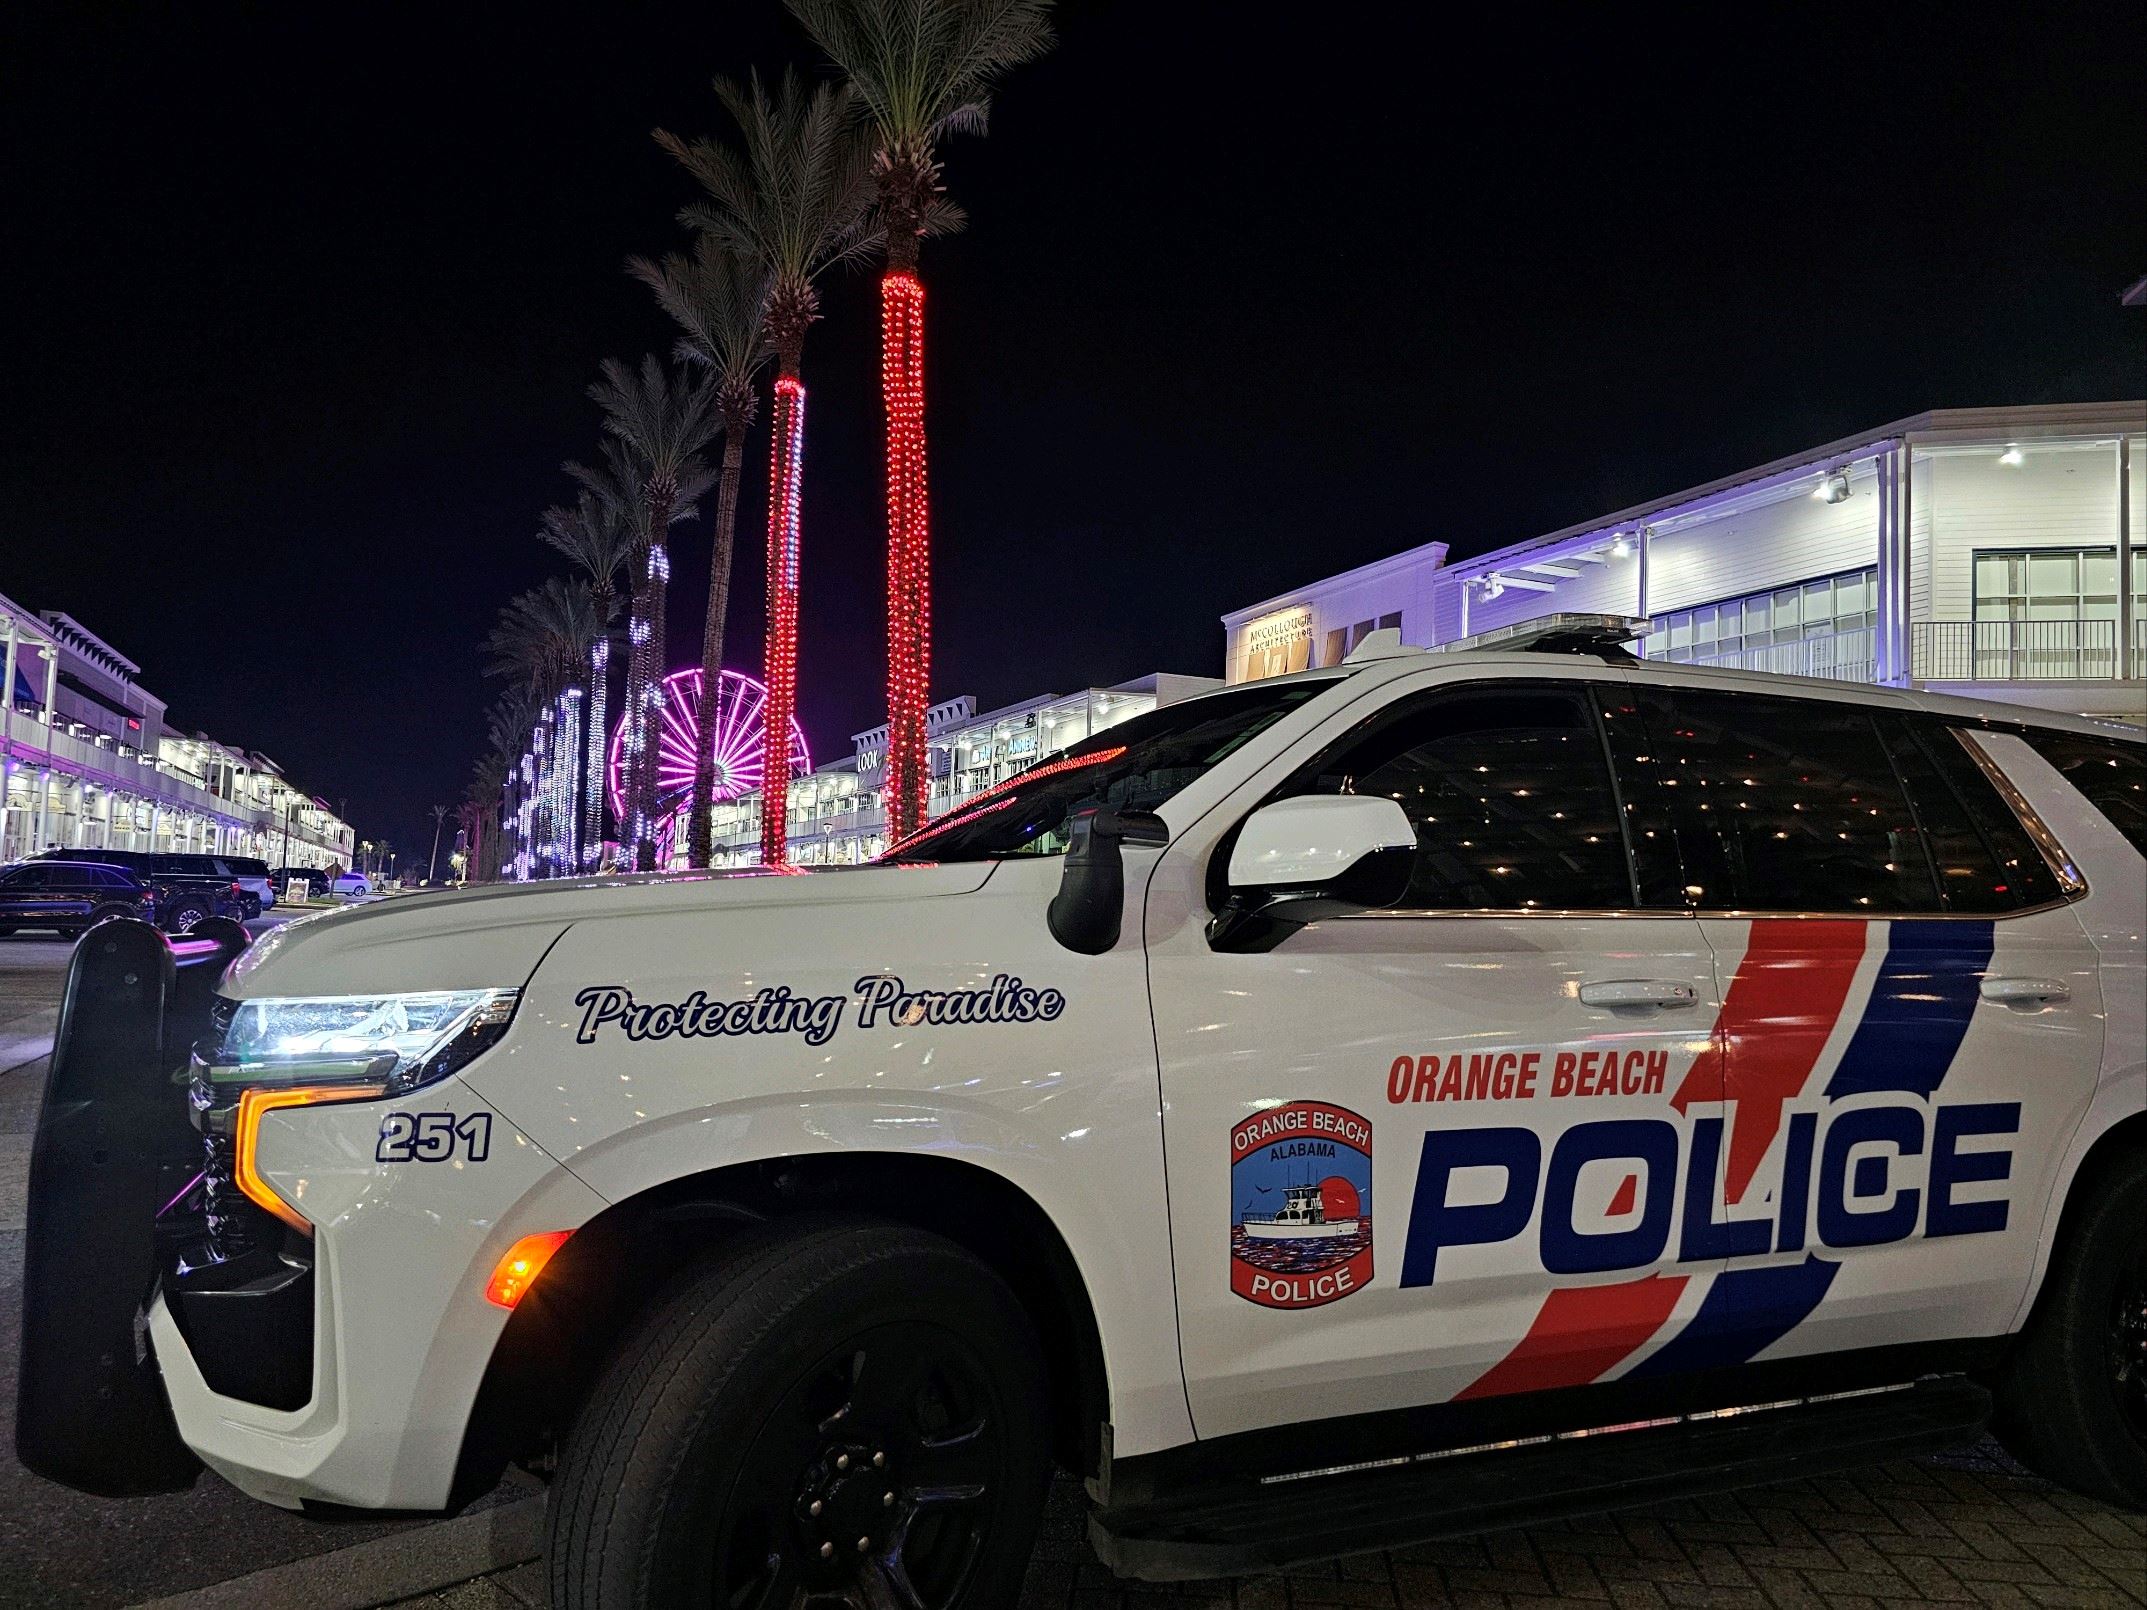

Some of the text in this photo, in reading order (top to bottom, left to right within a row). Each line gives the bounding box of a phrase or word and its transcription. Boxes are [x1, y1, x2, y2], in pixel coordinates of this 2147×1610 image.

[857, 749, 878, 773] LOOK
[575, 973, 1066, 1045] Protecting Paradise
[1387, 1050, 1668, 1105] ORANGE BEACH
[375, 1112, 493, 1163] 251
[1234, 1111, 1370, 1152] ORANGE BEACH
[1270, 1142, 1336, 1163] ALABAMA
[1399, 1101, 2022, 1289] POLICE
[1251, 1266, 1354, 1303] POLICE
